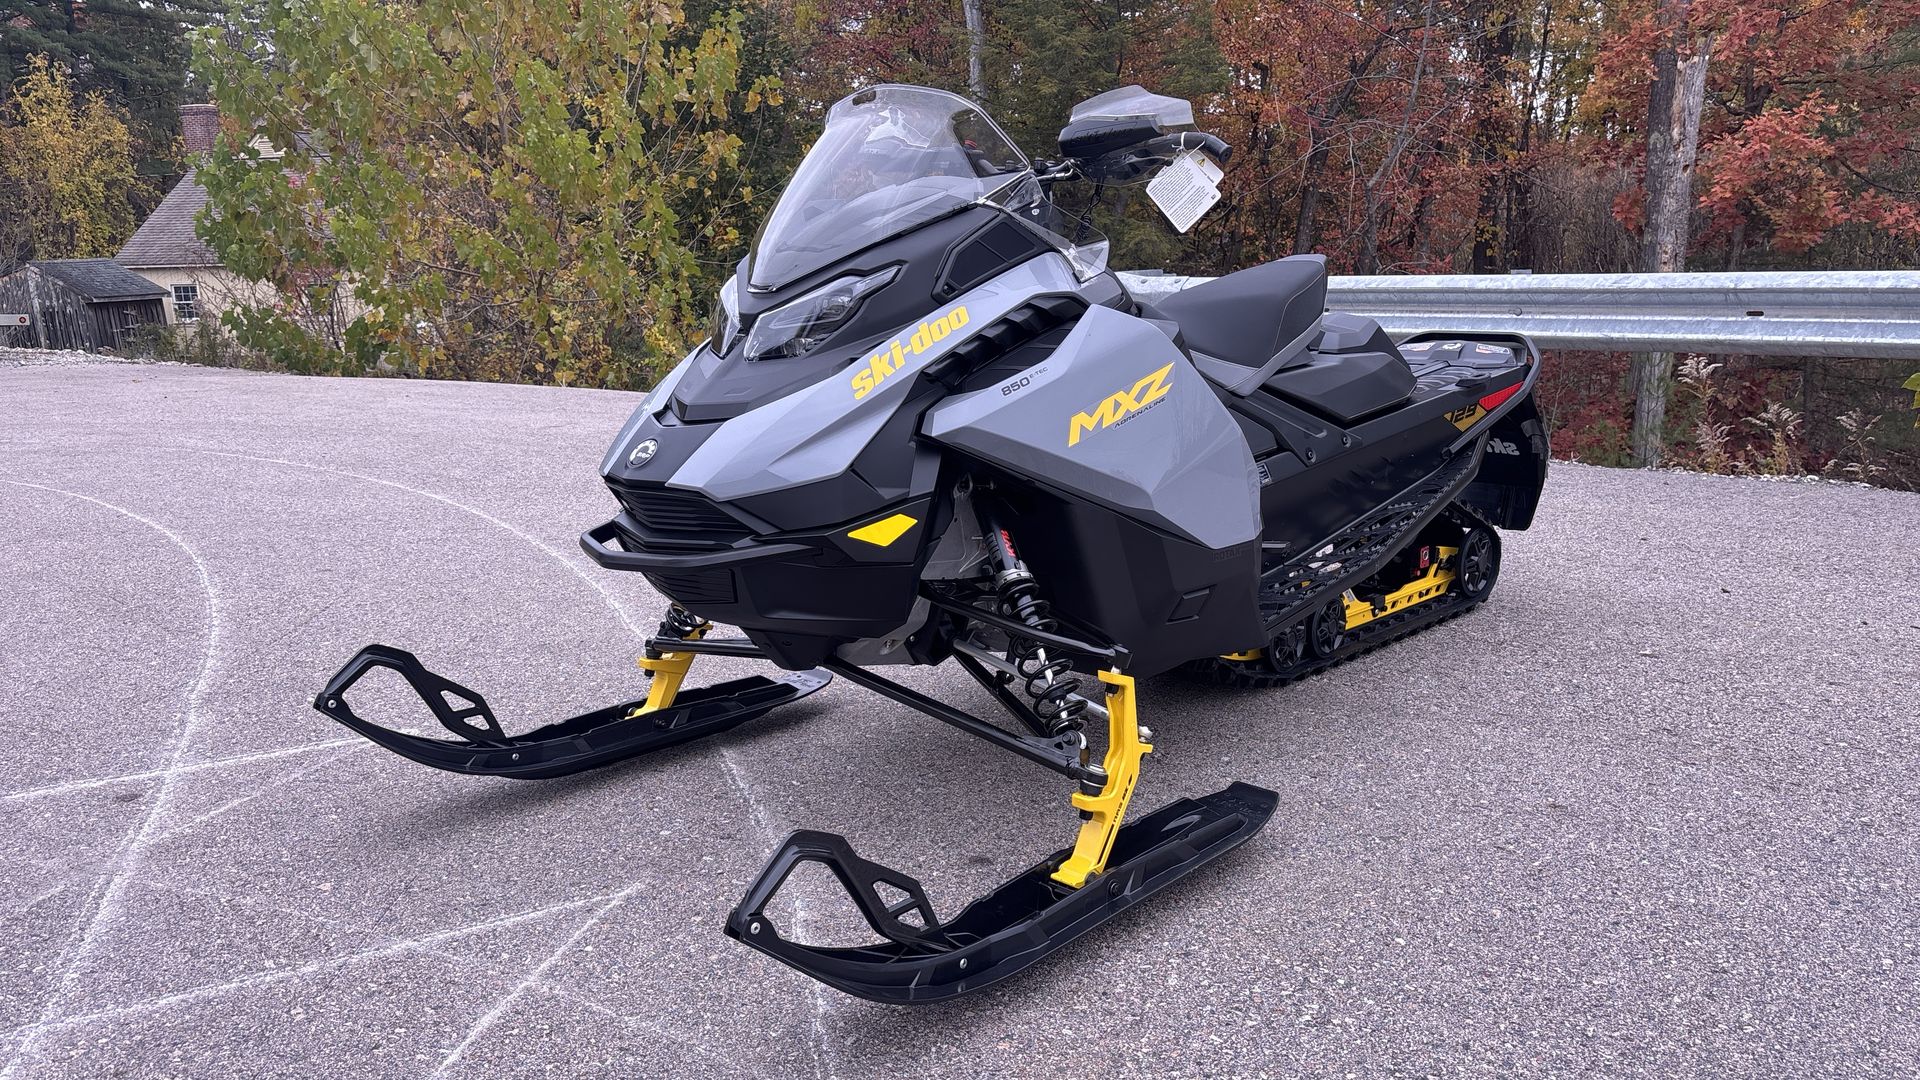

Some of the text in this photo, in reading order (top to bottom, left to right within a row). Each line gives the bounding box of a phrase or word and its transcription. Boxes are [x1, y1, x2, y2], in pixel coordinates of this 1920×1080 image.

[1001, 376, 1030, 397] 850
[1068, 361, 1175, 447] MXZ
[1114, 397, 1167, 428] ADRENALINE
